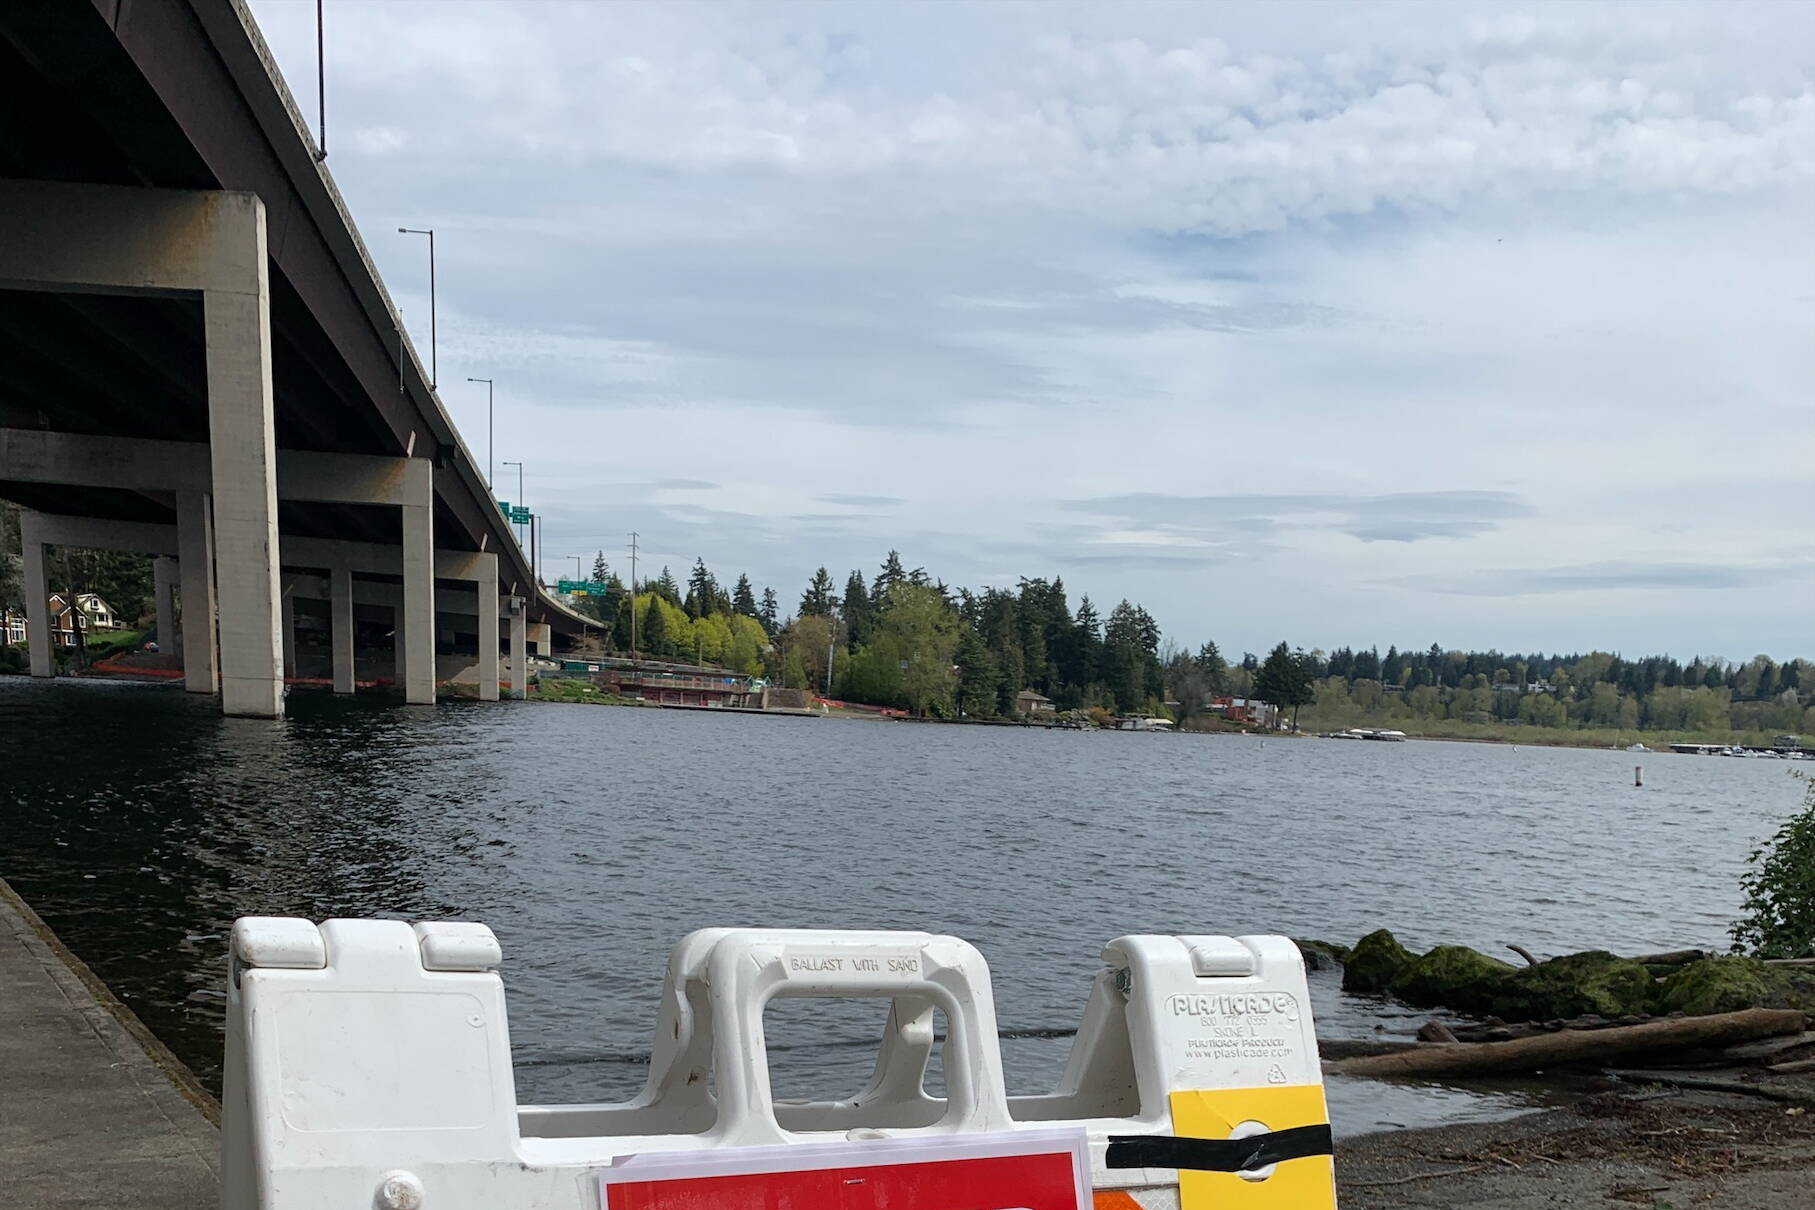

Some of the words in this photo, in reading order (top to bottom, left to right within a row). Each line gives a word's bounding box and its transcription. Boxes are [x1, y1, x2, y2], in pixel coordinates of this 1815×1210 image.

[792, 958, 842, 971] BALLAST
[852, 959, 880, 971] WITH
[888, 959, 918, 972] SAND
